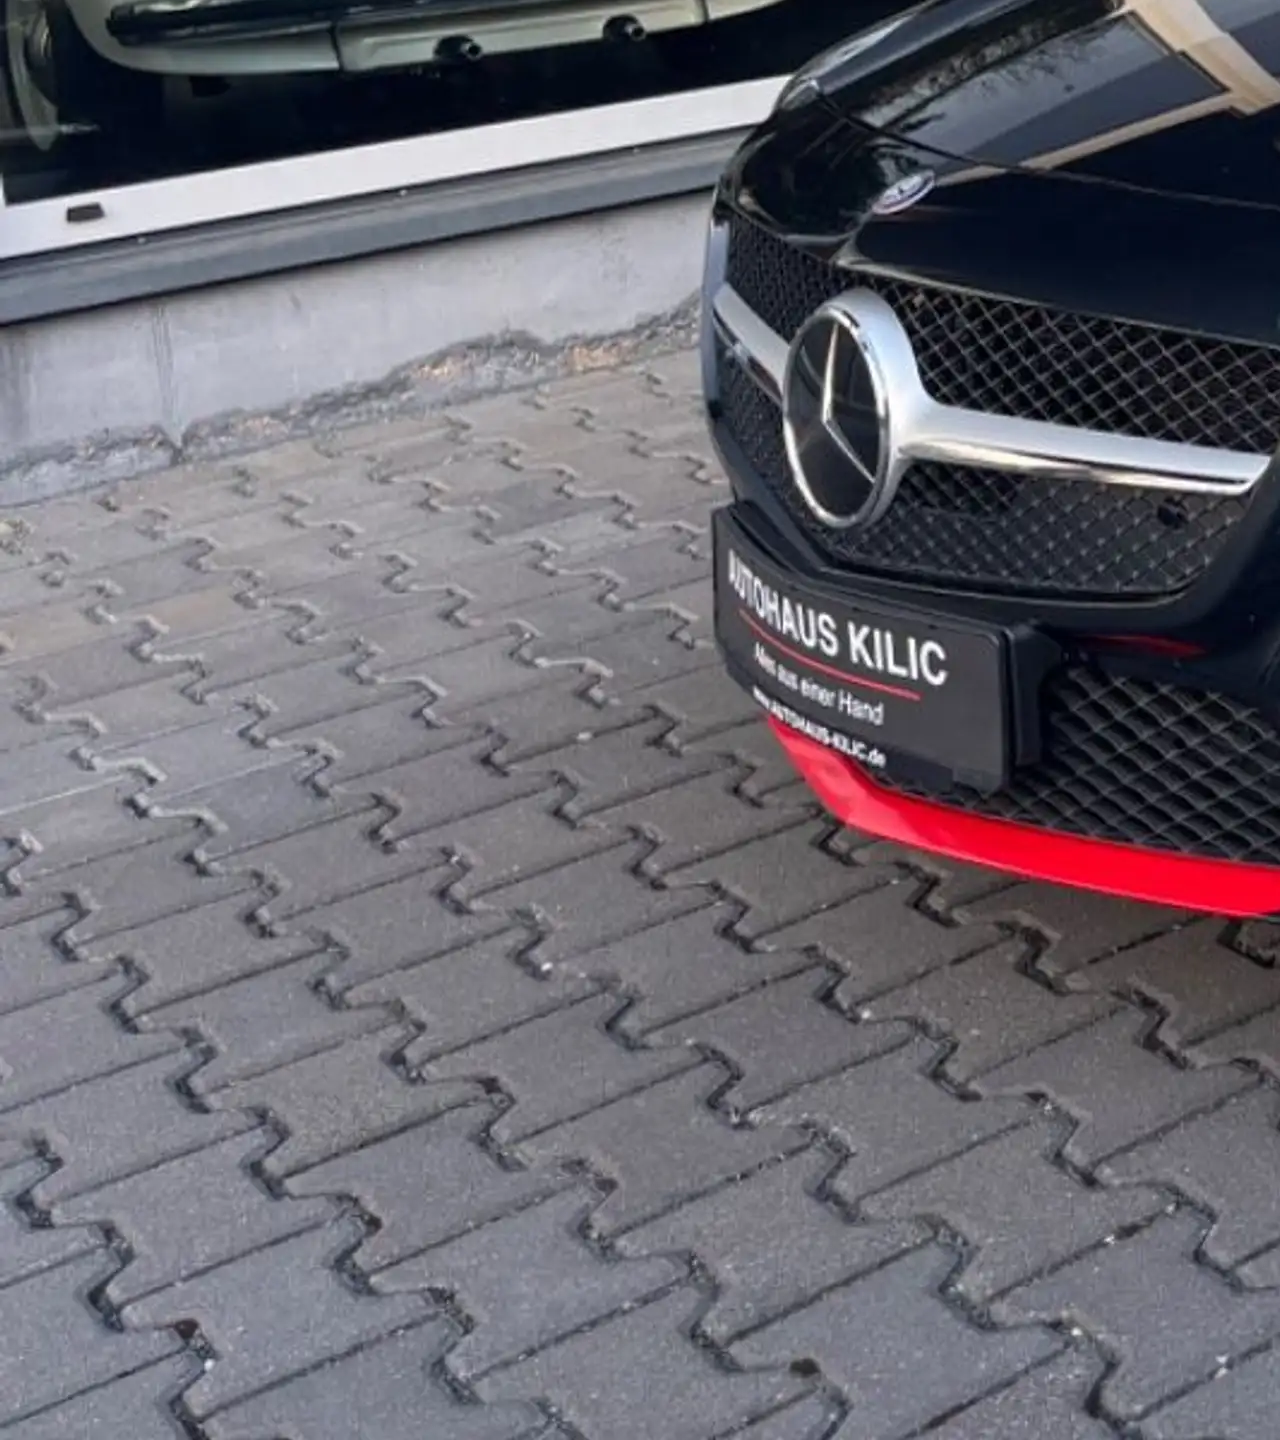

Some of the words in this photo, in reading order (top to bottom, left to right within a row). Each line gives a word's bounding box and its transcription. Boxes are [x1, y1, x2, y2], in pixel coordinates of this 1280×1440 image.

[728, 547, 839, 656] AUTOHAUS
[847, 620, 948, 686] KILIC
[837, 689, 885, 726] Hand
